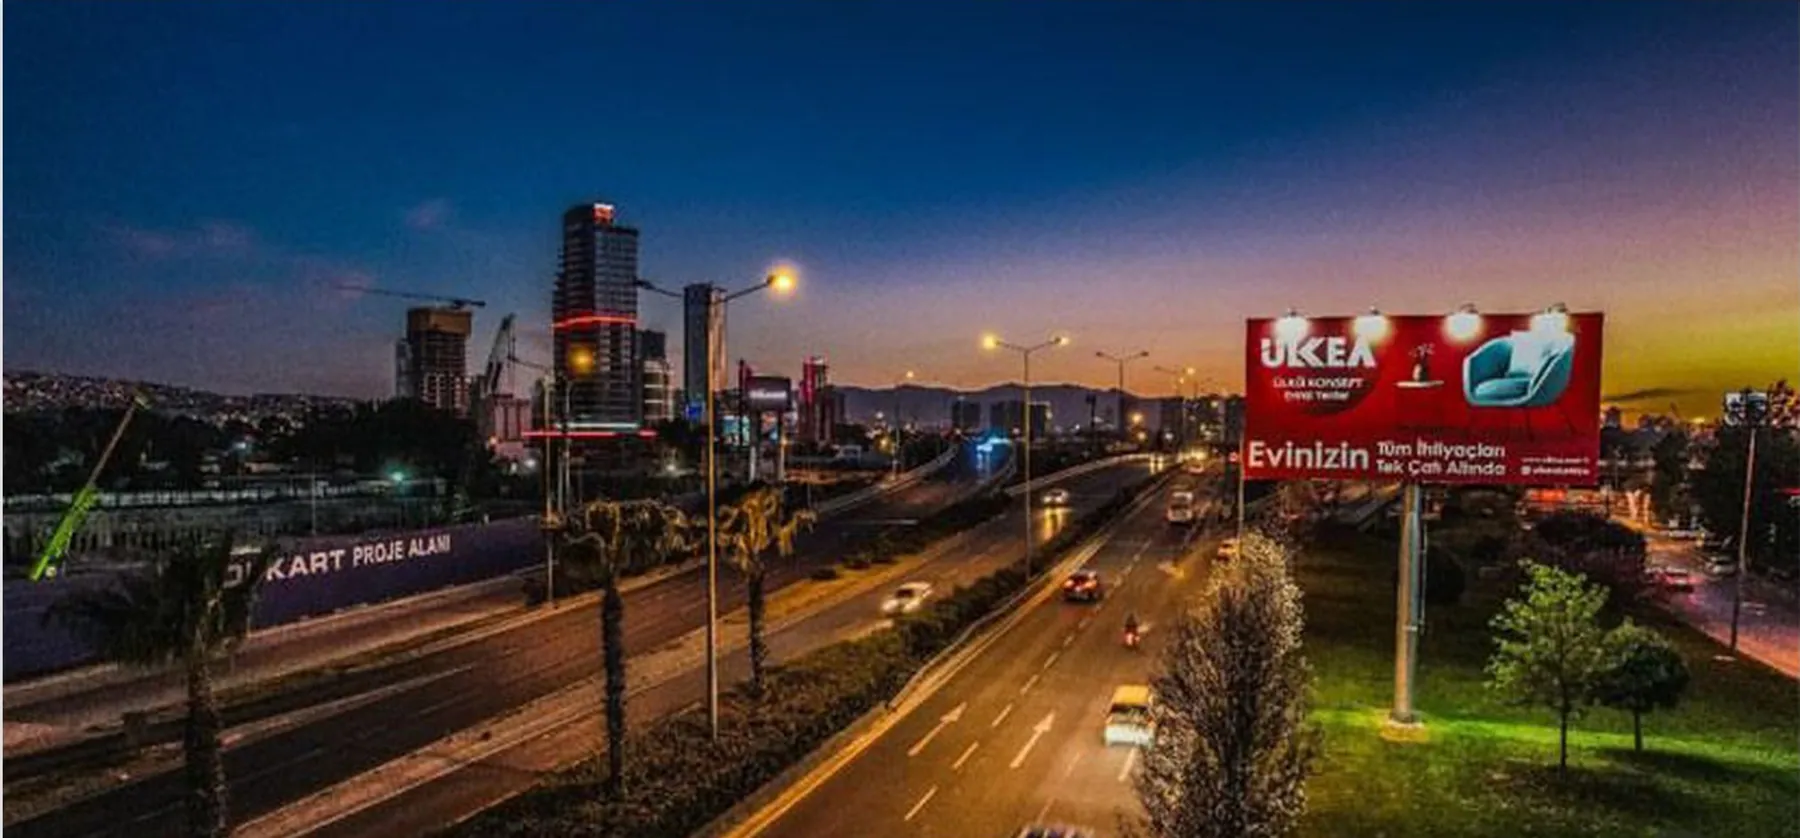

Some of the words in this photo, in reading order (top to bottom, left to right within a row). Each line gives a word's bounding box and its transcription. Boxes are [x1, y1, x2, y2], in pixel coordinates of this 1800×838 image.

[1247, 440, 1369, 470] Evinizin
[1376, 440, 1412, 457] Tüm
[1376, 459, 1404, 474] Tek
[352, 540, 404, 568] PROJE
[407, 533, 451, 558] ALANI
